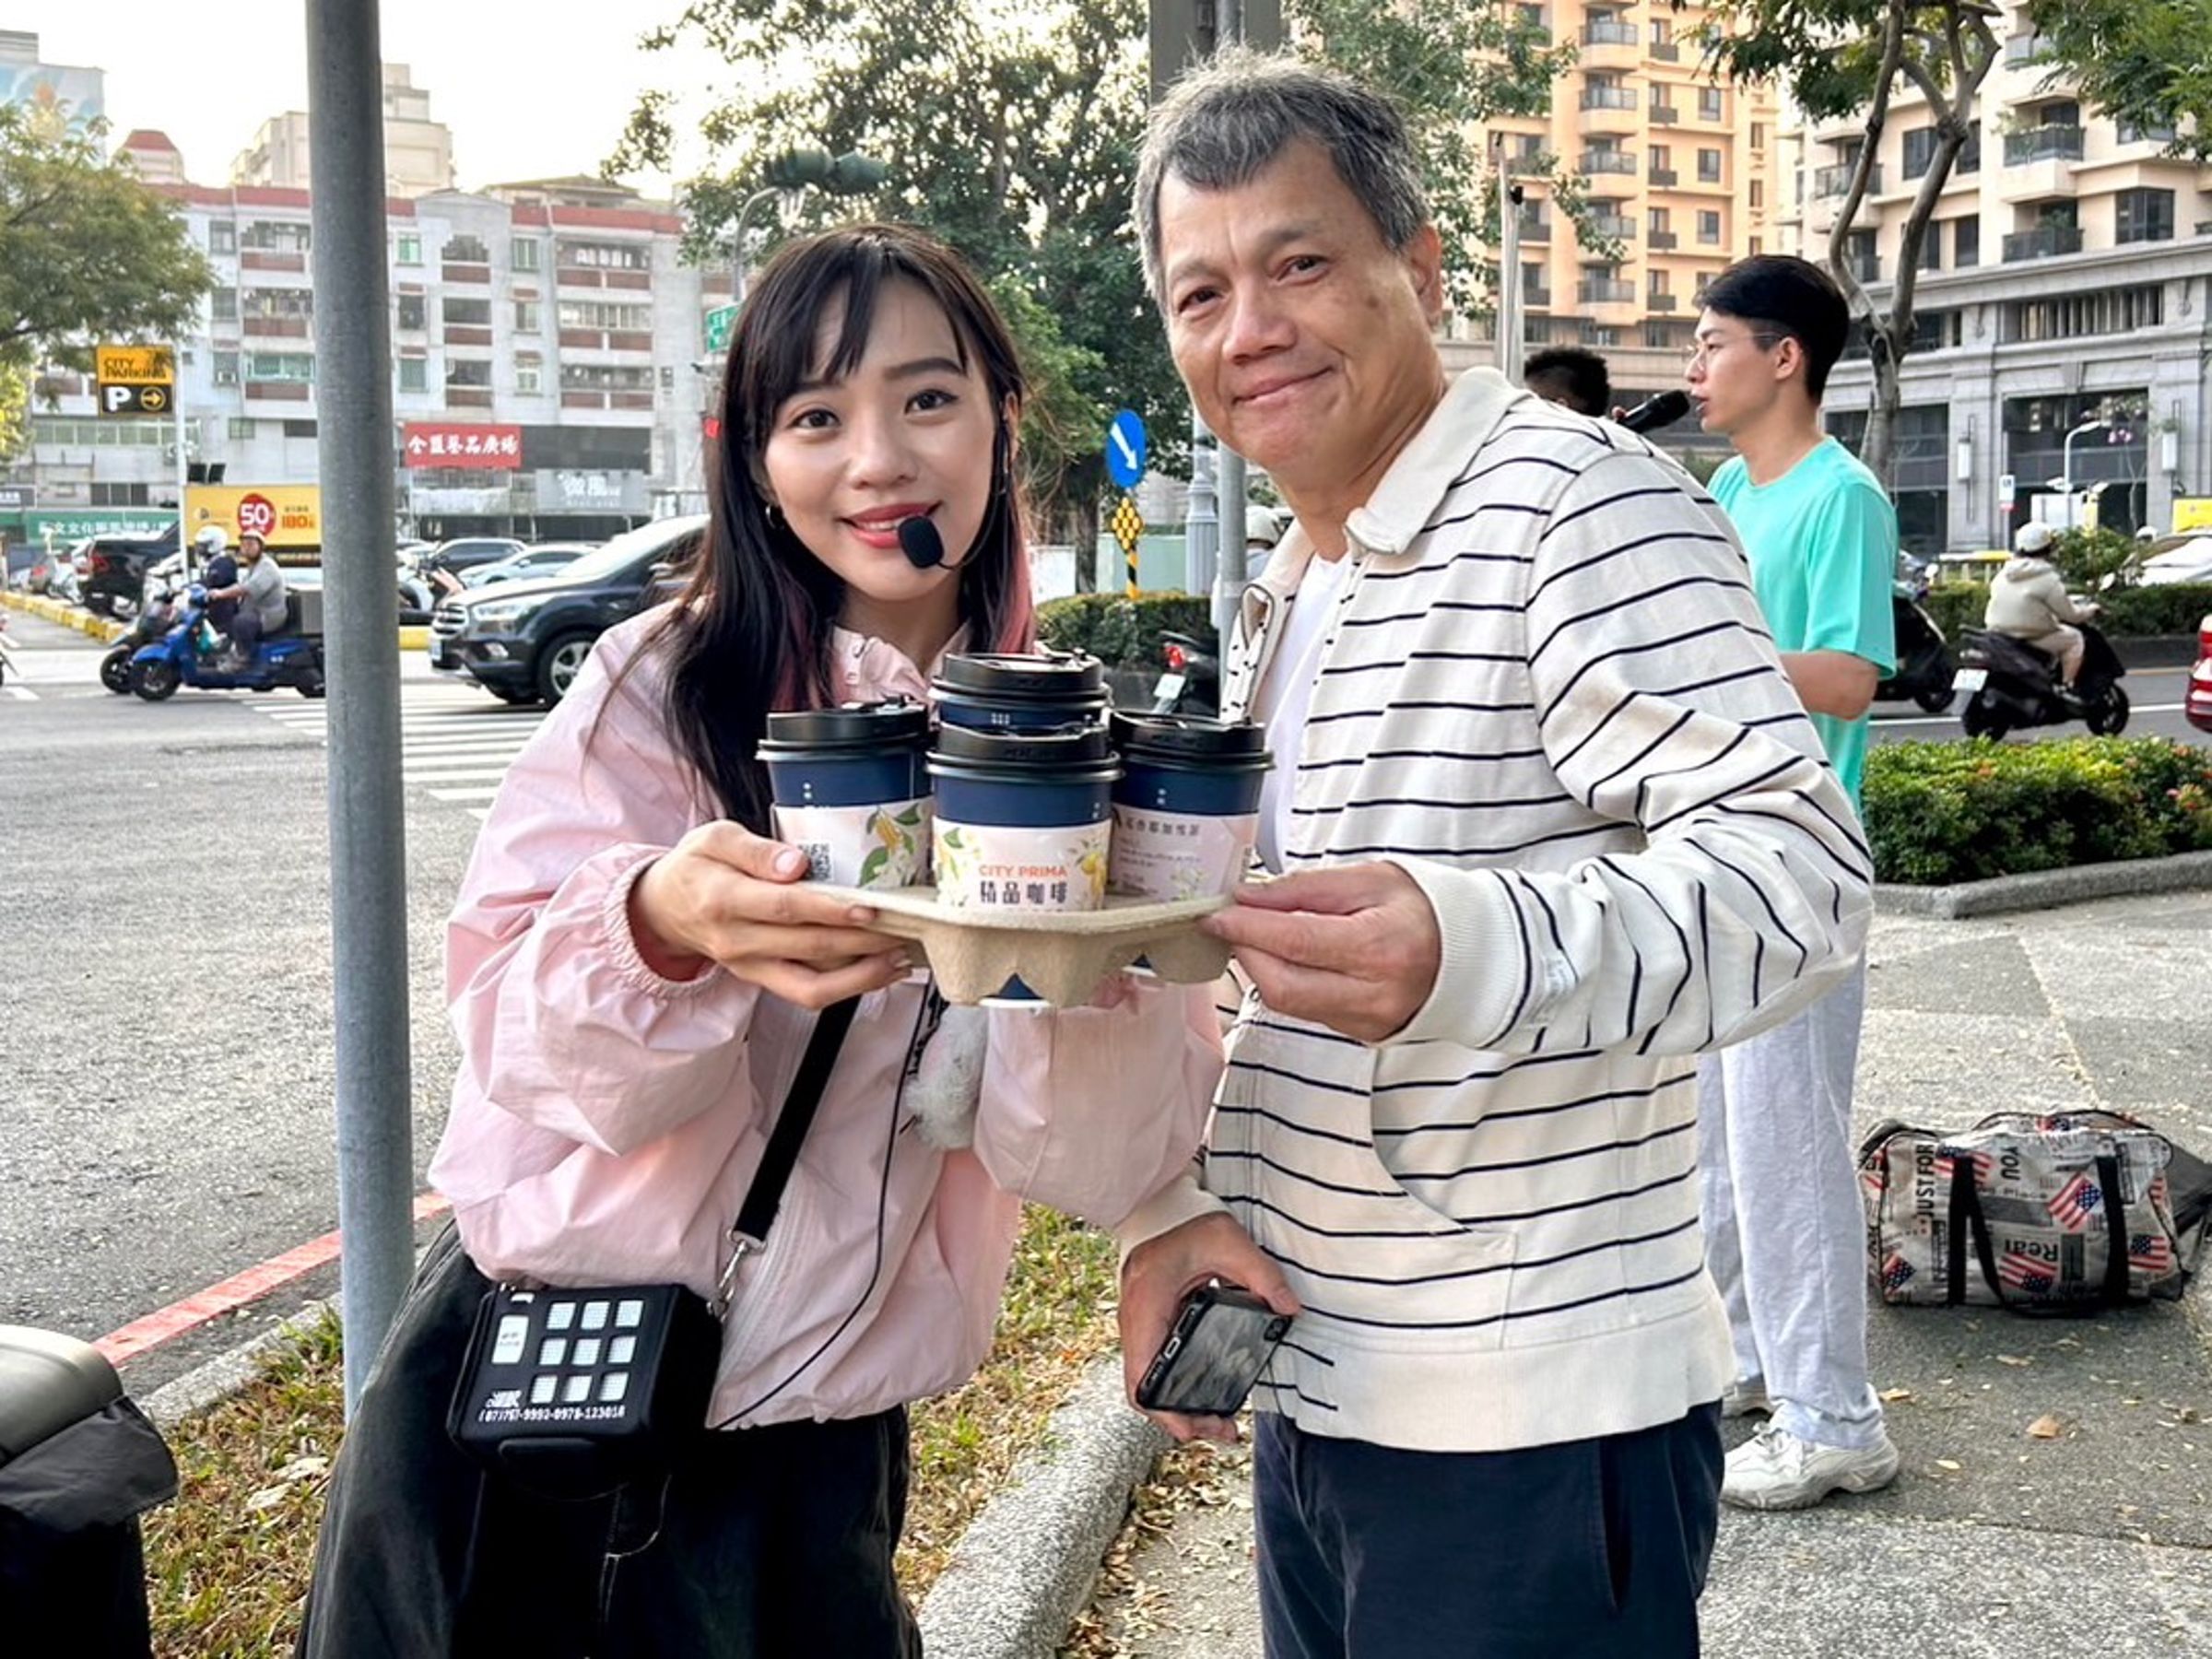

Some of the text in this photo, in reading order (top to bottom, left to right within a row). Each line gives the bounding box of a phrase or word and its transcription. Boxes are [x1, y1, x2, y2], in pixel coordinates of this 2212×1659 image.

[104, 358, 134, 369] CITY
[105, 368, 167, 379] PARKING
[105, 386, 132, 412] P
[241, 502, 270, 525] 50
[979, 865, 1068, 877] CITY PRIMA
[980, 880, 1068, 904] 精品咖啡
[2000, 1147, 2020, 1181] YOU
[1916, 1144, 1934, 1218] JUST FOR
